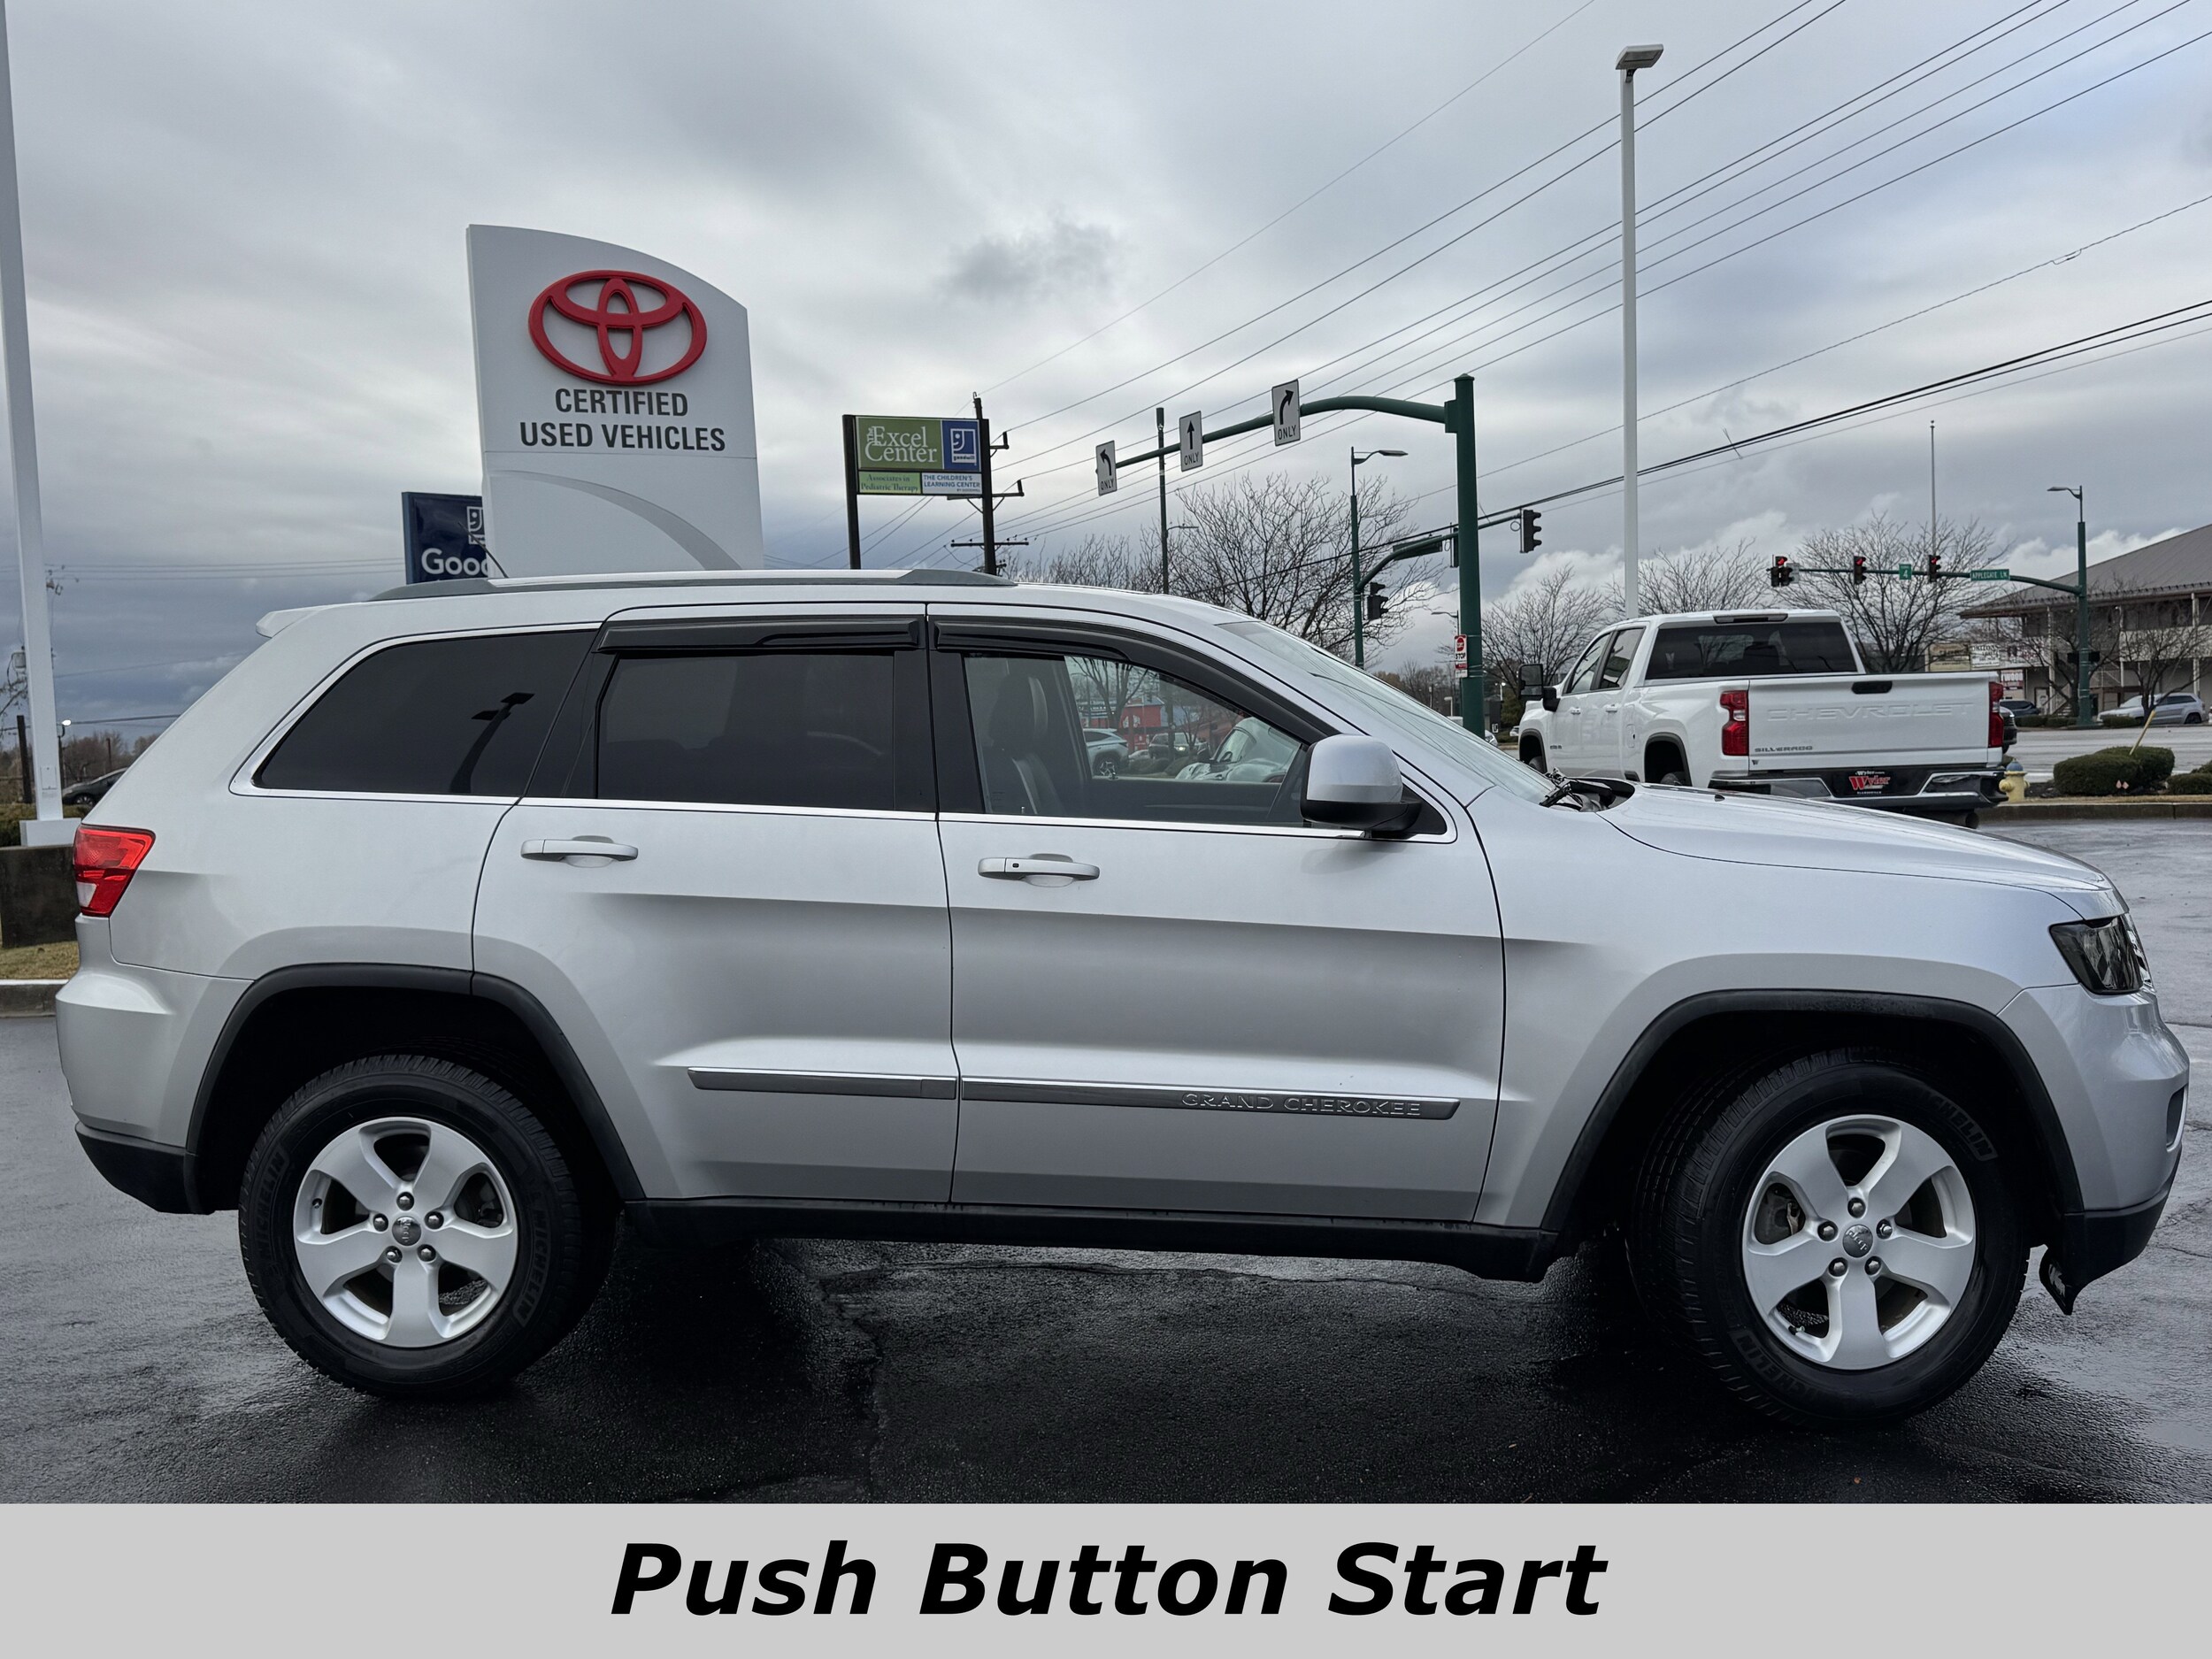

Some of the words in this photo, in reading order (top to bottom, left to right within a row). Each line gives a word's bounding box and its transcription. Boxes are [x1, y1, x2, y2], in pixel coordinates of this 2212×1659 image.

[556, 388, 688, 417] CERTIFIED
[520, 422, 593, 448] USED
[602, 425, 726, 452] VEHICLES
[872, 426, 929, 448] Excel
[1277, 425, 1297, 441] ONLY
[864, 441, 937, 463] Center
[1184, 451, 1200, 465] ONLY
[892, 483, 918, 493] Therapy
[1100, 478, 1115, 491] ONLY
[1971, 571, 1998, 580] APPLEGATE
[1767, 702, 1976, 722] CHEVROLET
[1848, 775, 1891, 791] Wyler
[1181, 1093, 1274, 1110] GRAND
[1283, 1096, 1421, 1117] CHEROKEE
[255, 1150, 288, 1262] MICHELIN
[511, 1209, 552, 1321] MICHELIN
